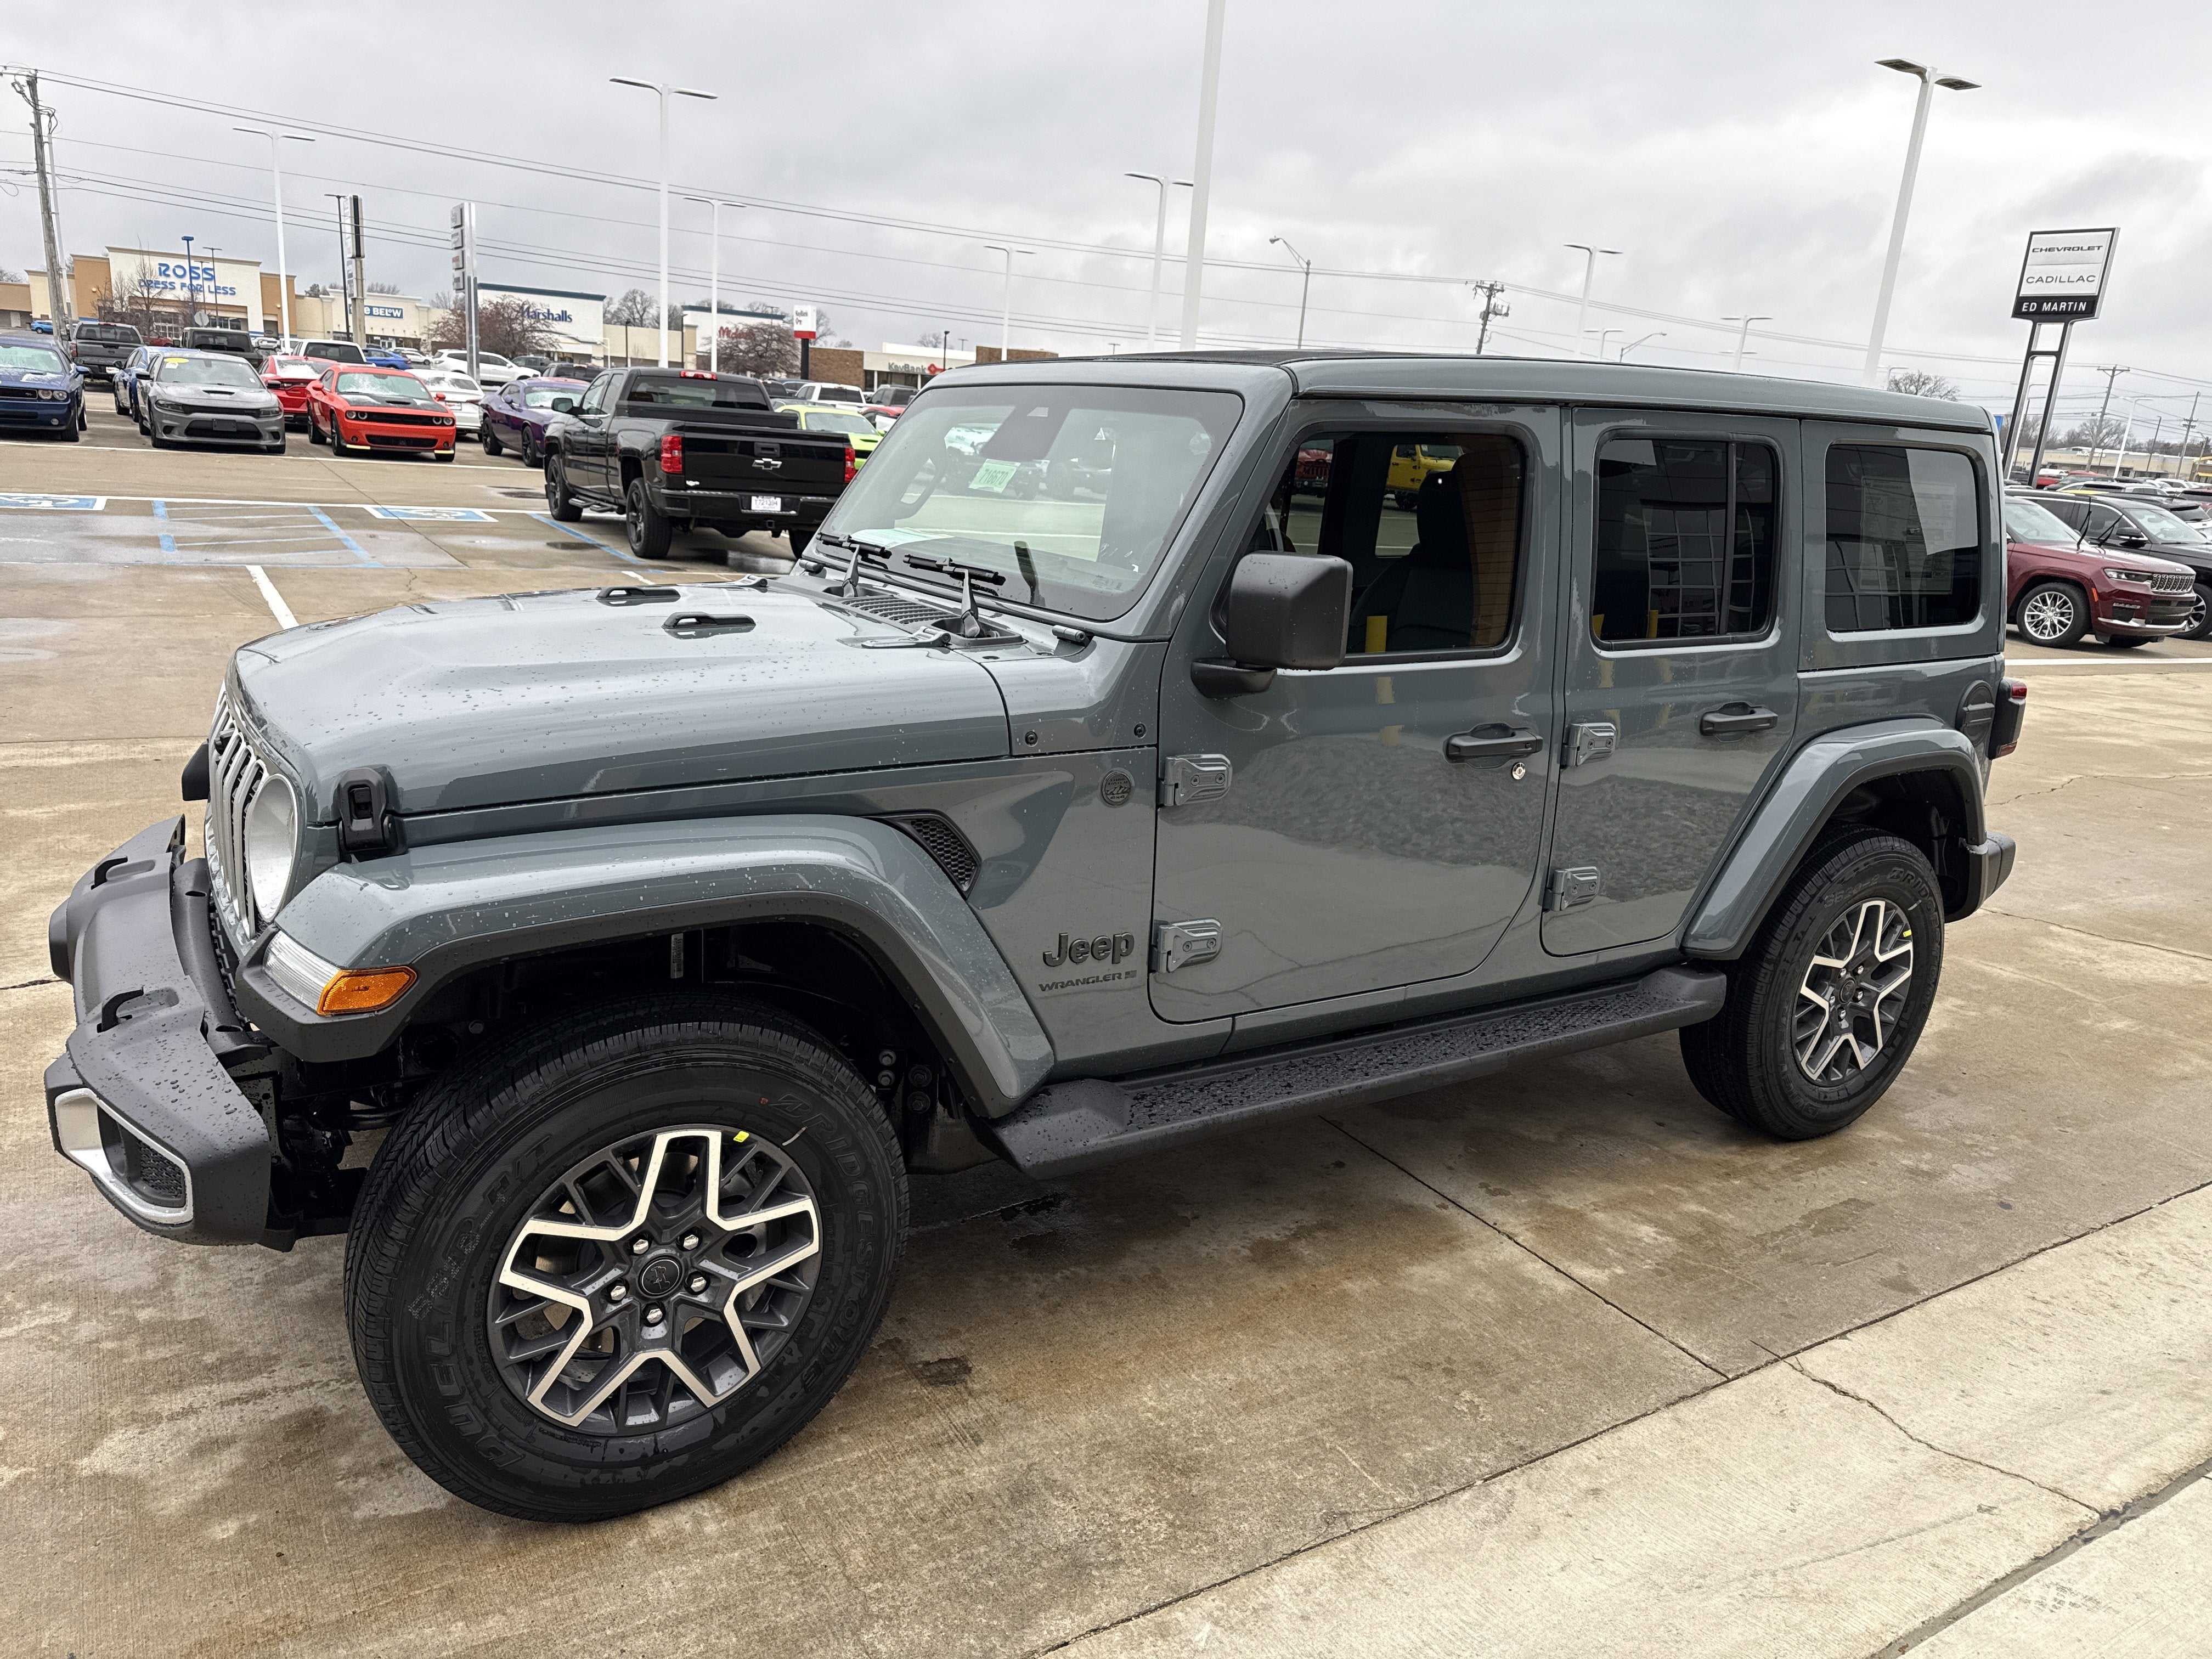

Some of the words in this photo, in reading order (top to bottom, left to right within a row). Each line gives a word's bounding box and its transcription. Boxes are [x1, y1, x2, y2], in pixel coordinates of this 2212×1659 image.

[158, 263, 215, 281] ROSS
[2026, 275, 2096, 284] CADILLAC
[139, 279, 176, 290] DRESS
[180, 282, 202, 292] FOR
[208, 284, 236, 295] LESS
[519, 305, 572, 323] Marshalls
[2022, 302, 2037, 312] ED
[2041, 302, 2087, 312] MARTIN
[888, 362, 927, 373] KeyBank
[1043, 932, 1135, 967] Jeep
[1039, 972, 1122, 992] WRANGLER
[769, 1093, 876, 1395] BRIDGESTONE
